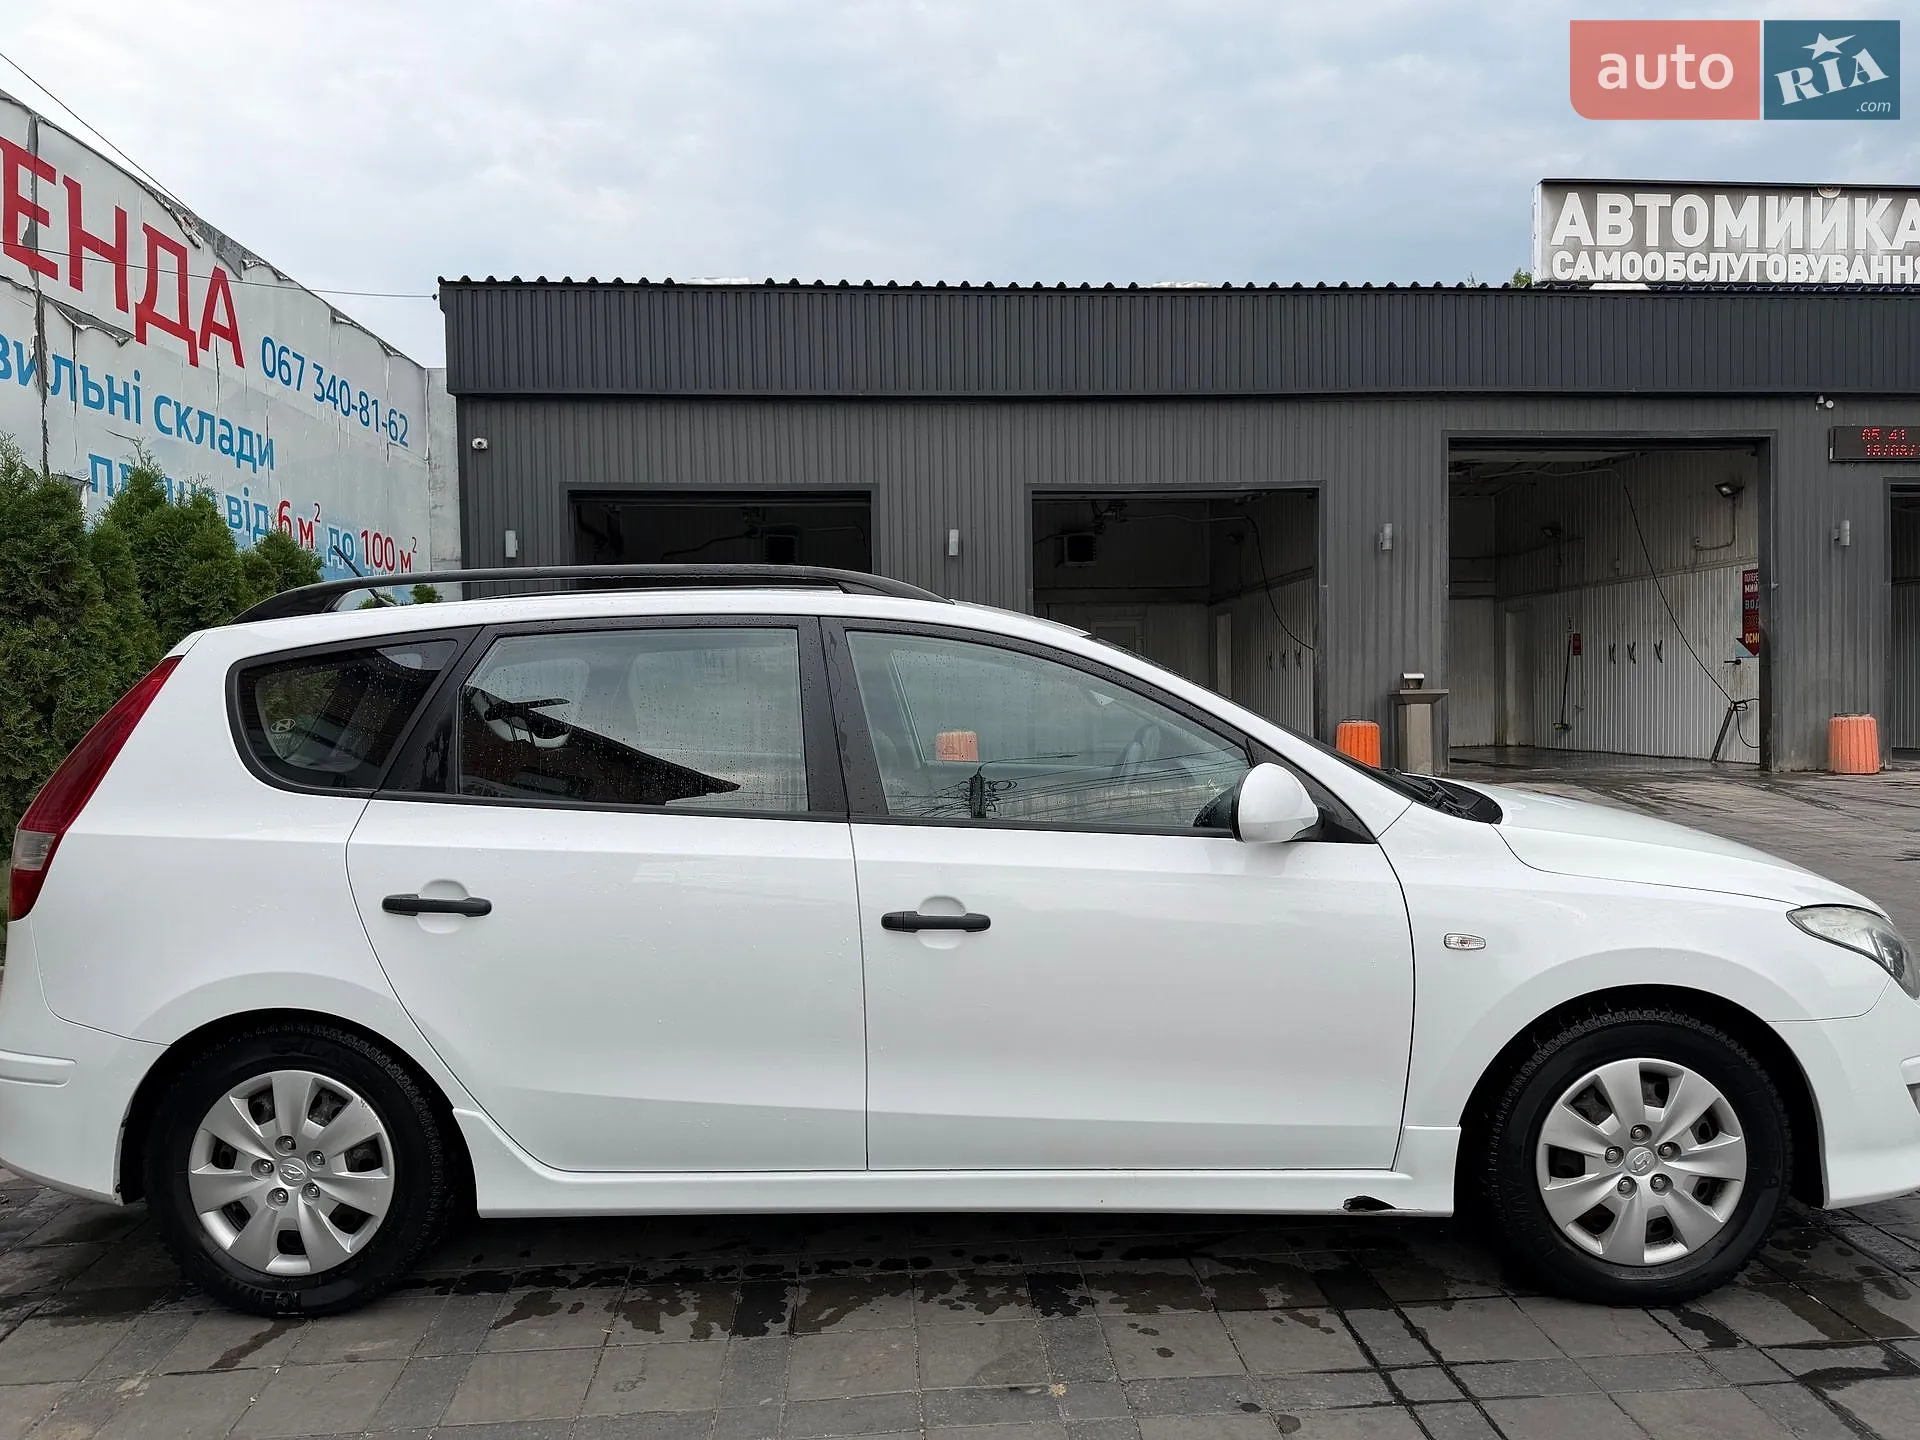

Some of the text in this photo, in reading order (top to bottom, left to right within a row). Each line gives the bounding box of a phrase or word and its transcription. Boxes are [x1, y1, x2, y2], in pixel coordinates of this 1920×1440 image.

[0, 135, 245, 369] ЕНДА
[1550, 192, 1920, 251] АВТОМИЙКА
[153, 394, 276, 474] склади
[262, 336, 409, 448] 067 340-81-62
[225, 487, 269, 543] від
[277, 500, 293, 540] 6
[327, 527, 355, 567] до
[361, 530, 395, 572] 100
